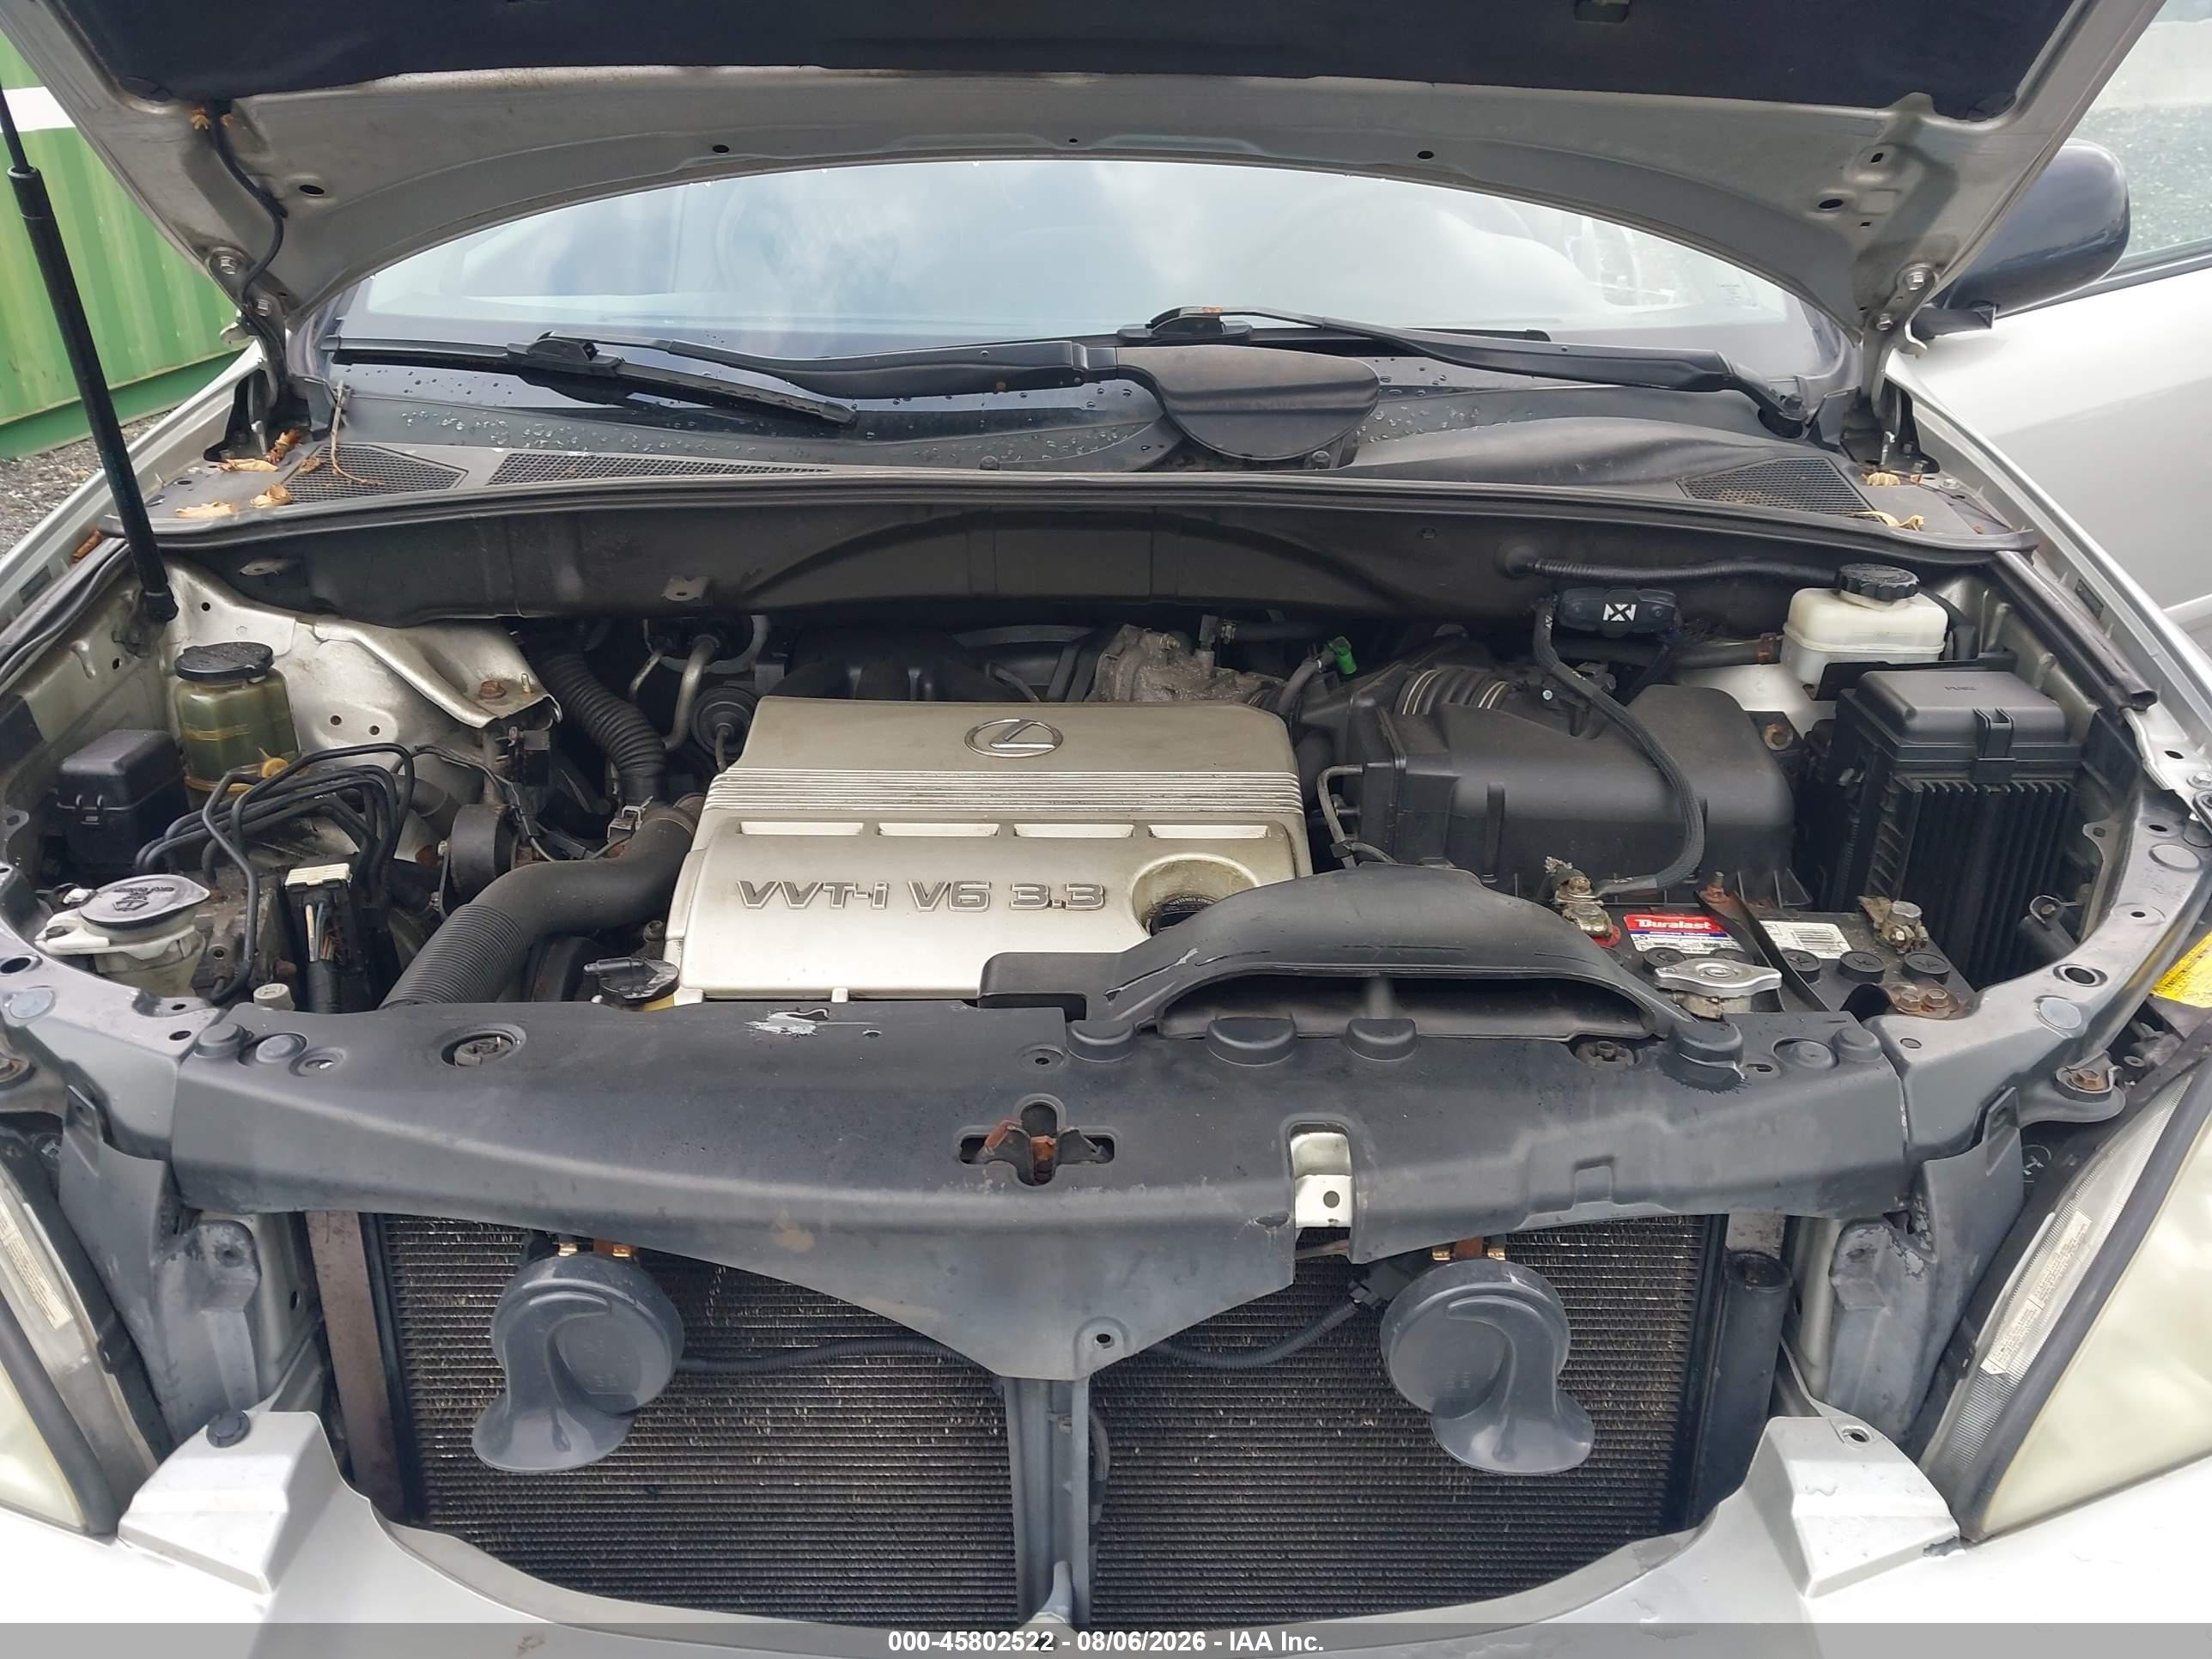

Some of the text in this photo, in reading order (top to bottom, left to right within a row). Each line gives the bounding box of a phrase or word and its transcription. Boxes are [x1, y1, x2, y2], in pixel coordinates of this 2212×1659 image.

[737, 880, 1105, 912] VVT-i V6 3.3
[1635, 919, 1711, 930] Duralast
